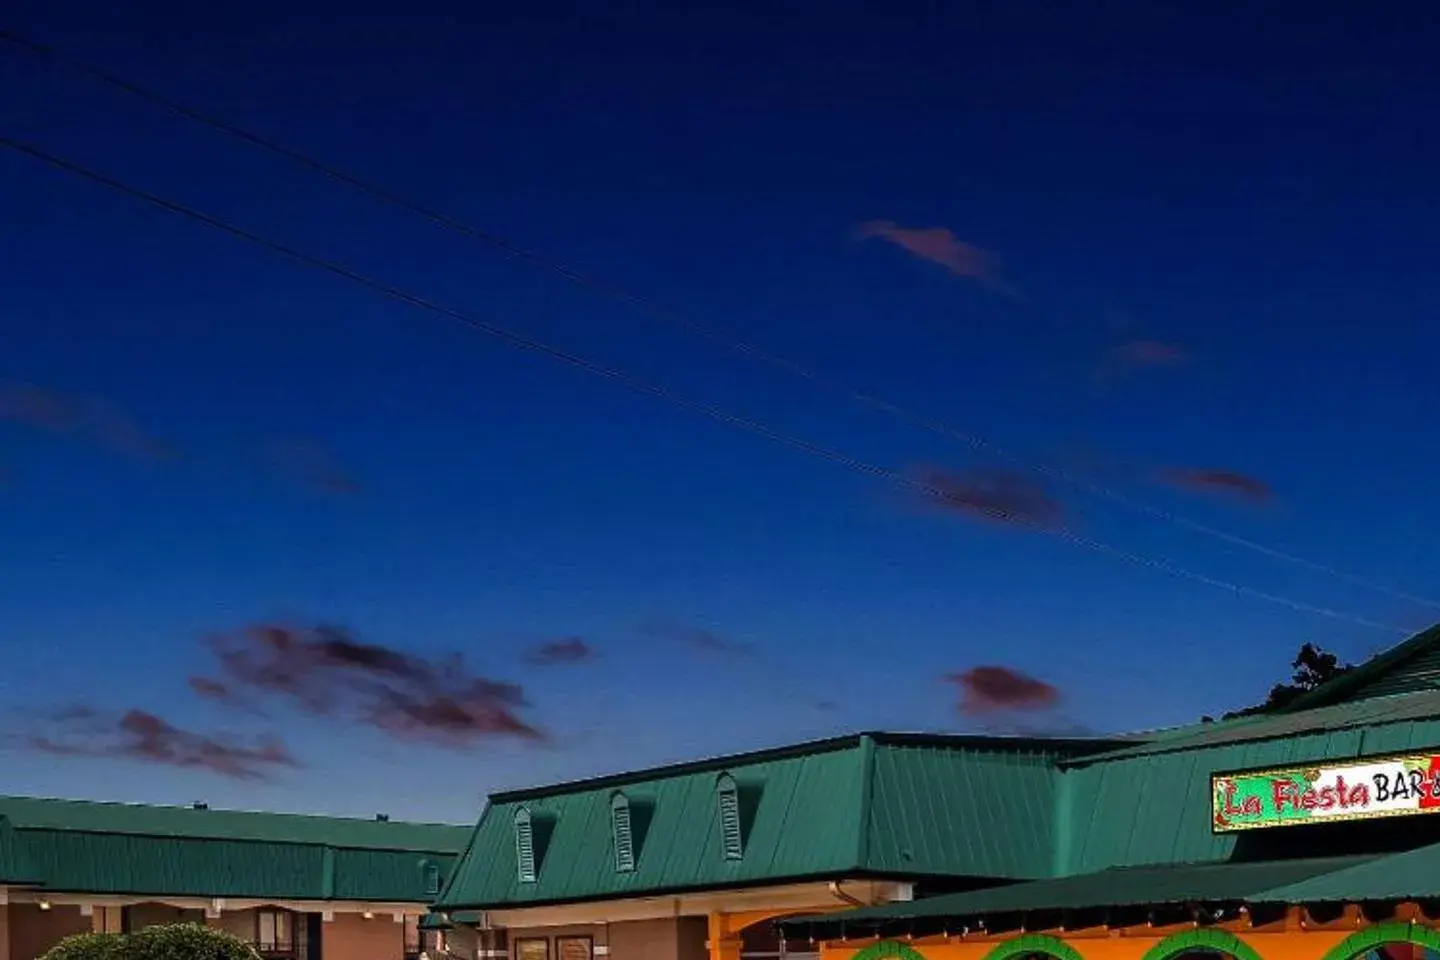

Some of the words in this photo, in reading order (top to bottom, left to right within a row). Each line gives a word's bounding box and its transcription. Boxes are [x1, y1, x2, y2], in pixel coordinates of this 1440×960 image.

[1224, 779, 1263, 815] La
[1272, 775, 1370, 811] Fiesta
[1372, 768, 1426, 802] BAR
